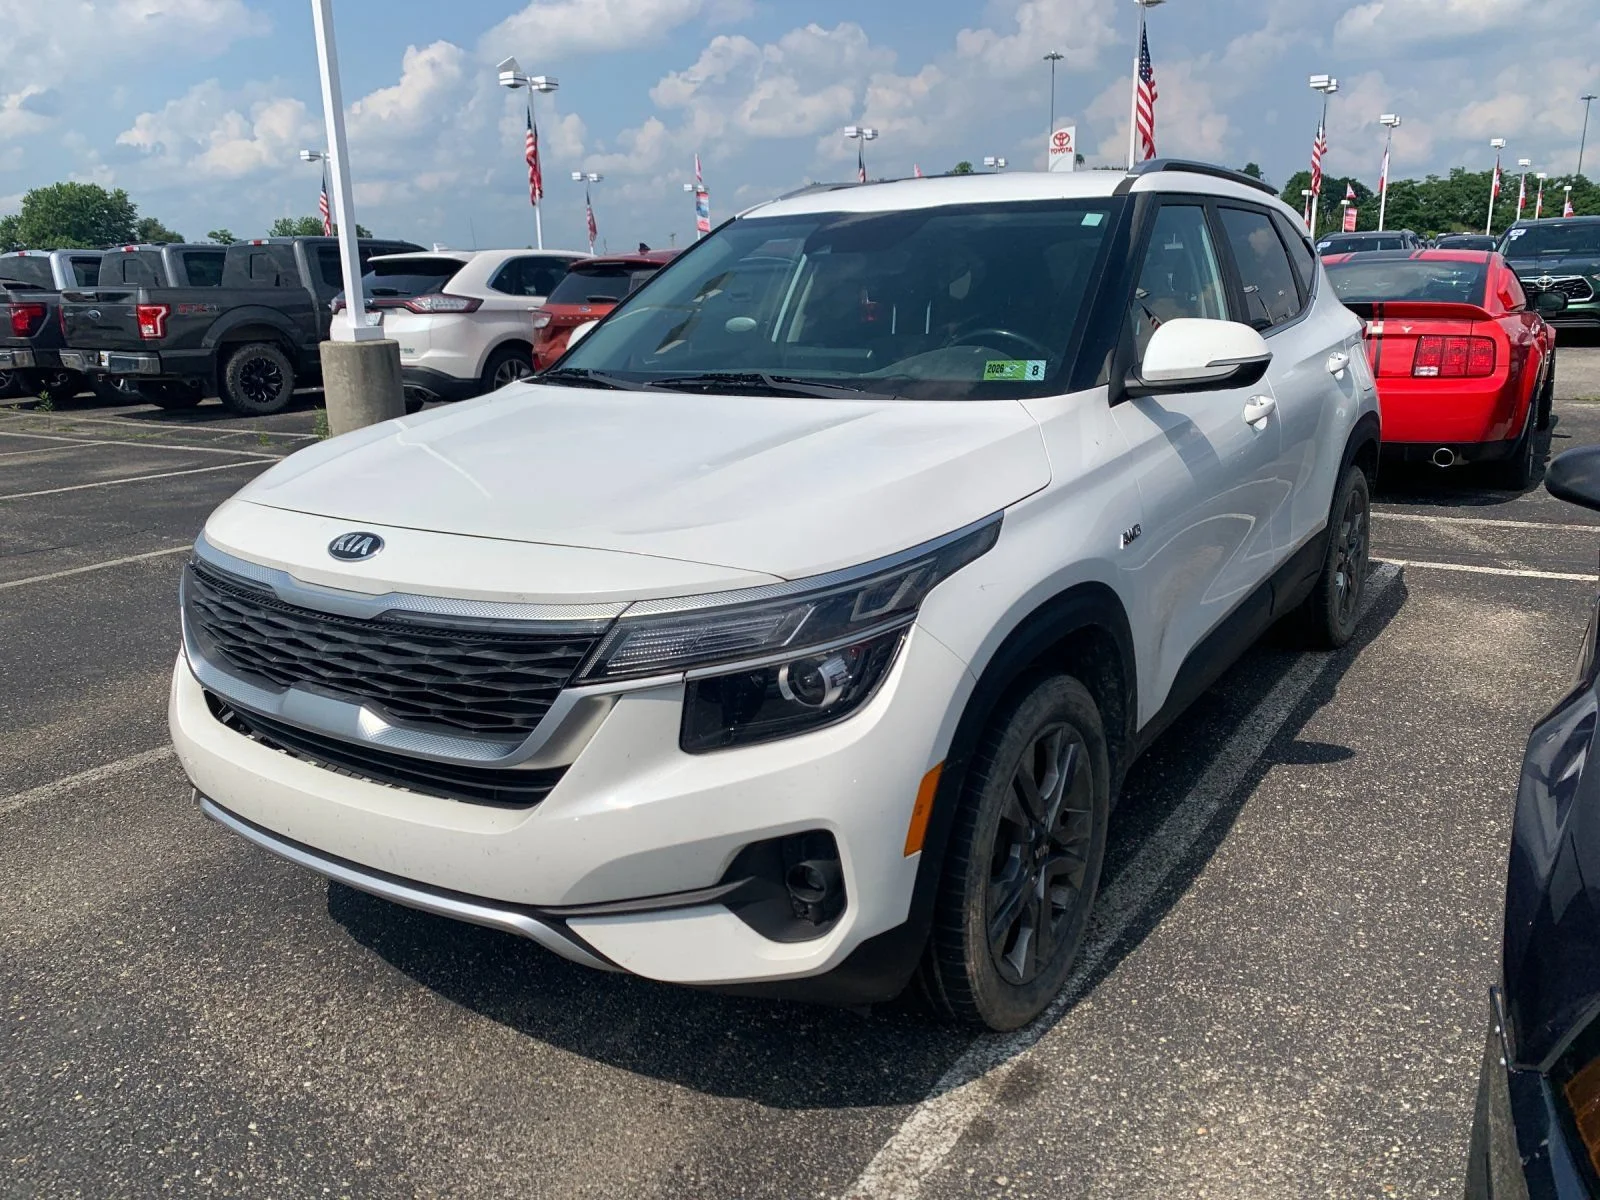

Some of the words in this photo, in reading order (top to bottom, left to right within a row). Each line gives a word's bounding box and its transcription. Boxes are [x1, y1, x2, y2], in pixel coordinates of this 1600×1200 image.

[1050, 147, 1073, 155] TOYOTA
[987, 364, 1005, 374] 2026
[1032, 365, 1040, 376] 8
[331, 534, 374, 556] KIA
[1120, 523, 1142, 550] AWD
